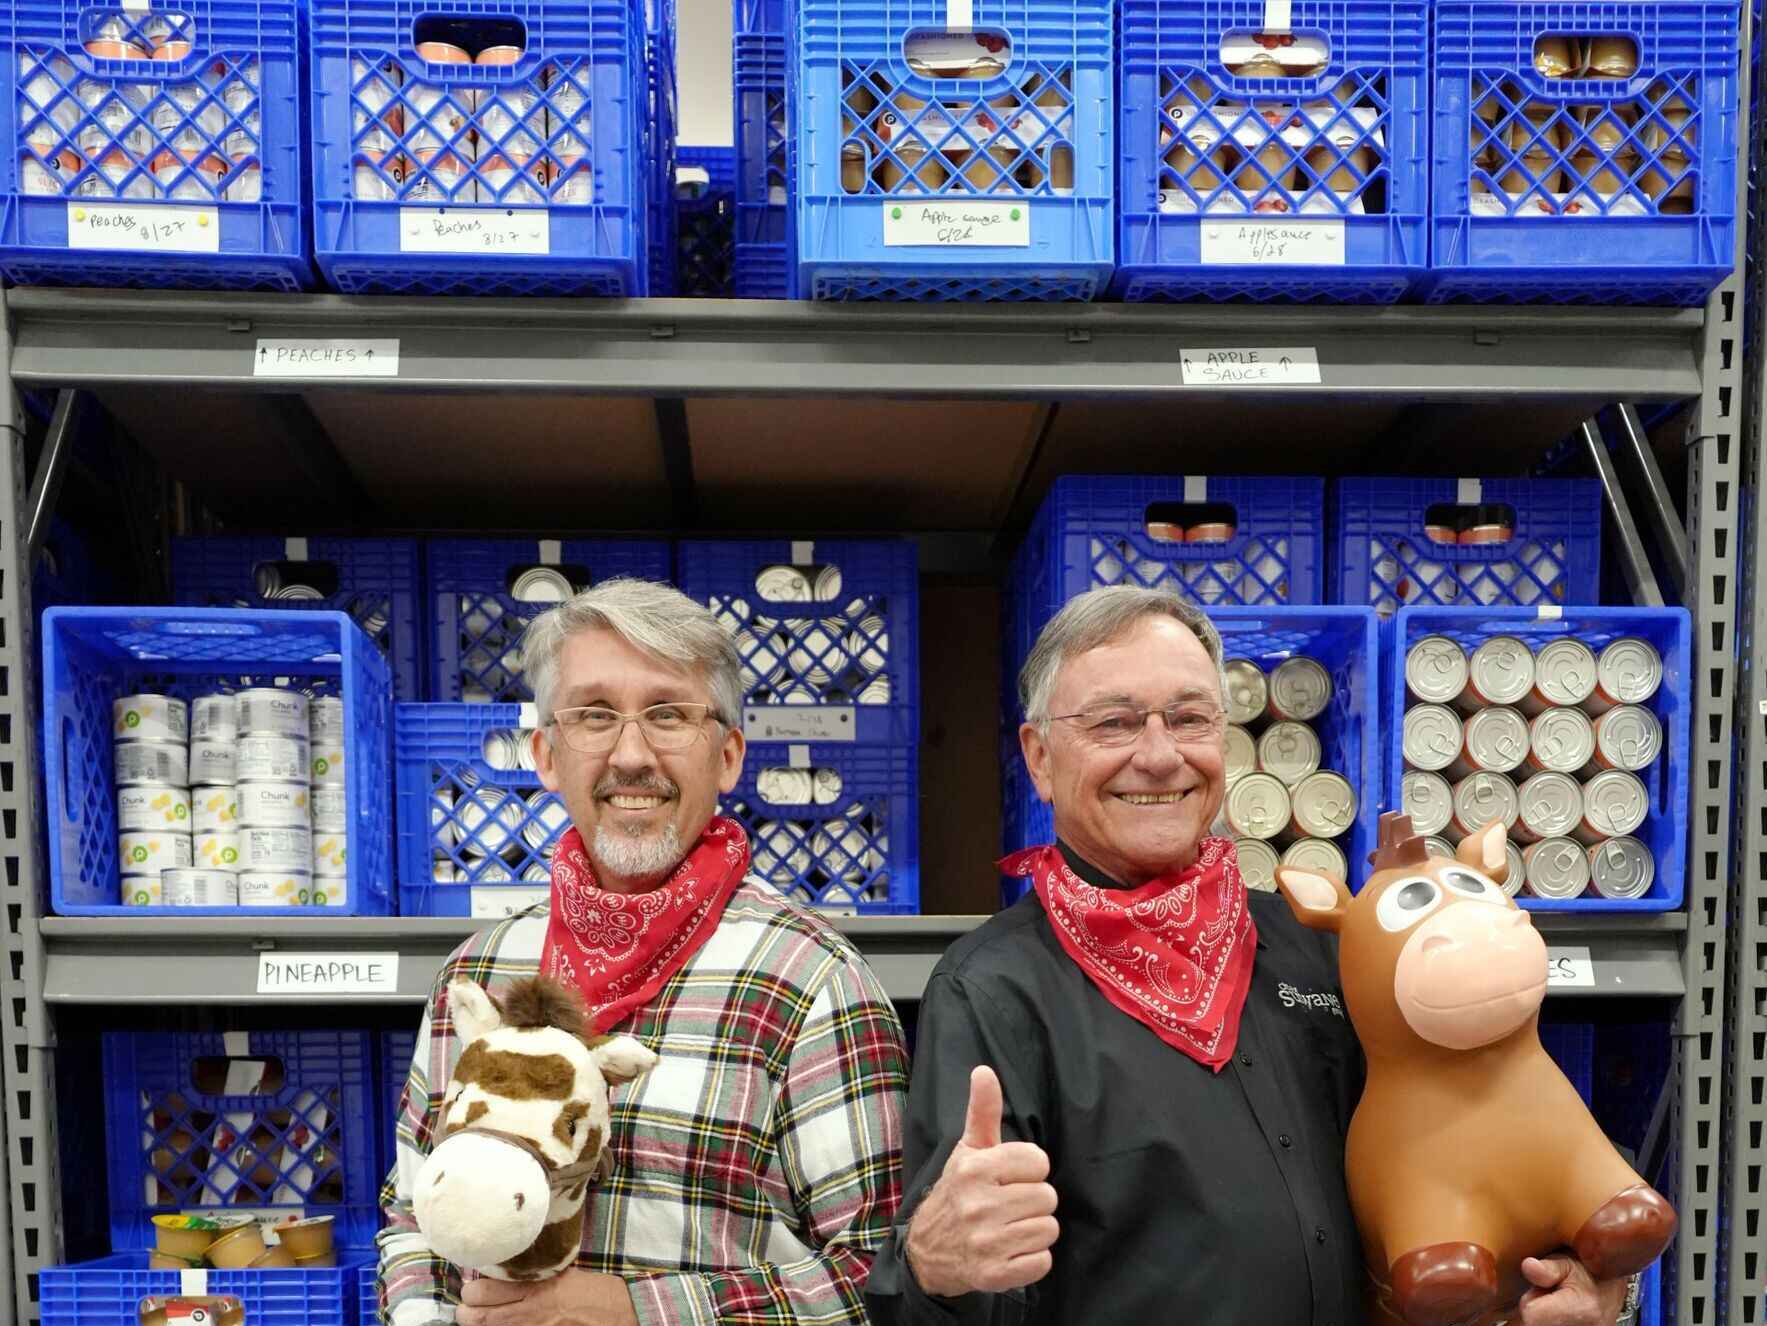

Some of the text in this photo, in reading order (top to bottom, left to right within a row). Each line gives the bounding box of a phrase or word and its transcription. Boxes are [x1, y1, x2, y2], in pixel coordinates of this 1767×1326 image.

[276, 347, 357, 363] PEACHES
[1207, 351, 1259, 367] APPLE
[1202, 367, 1269, 381] SAUCE
[260, 791, 289, 800] Chunk
[243, 881, 270, 890] Chunk
[264, 961, 385, 984] PINEAPPLE
